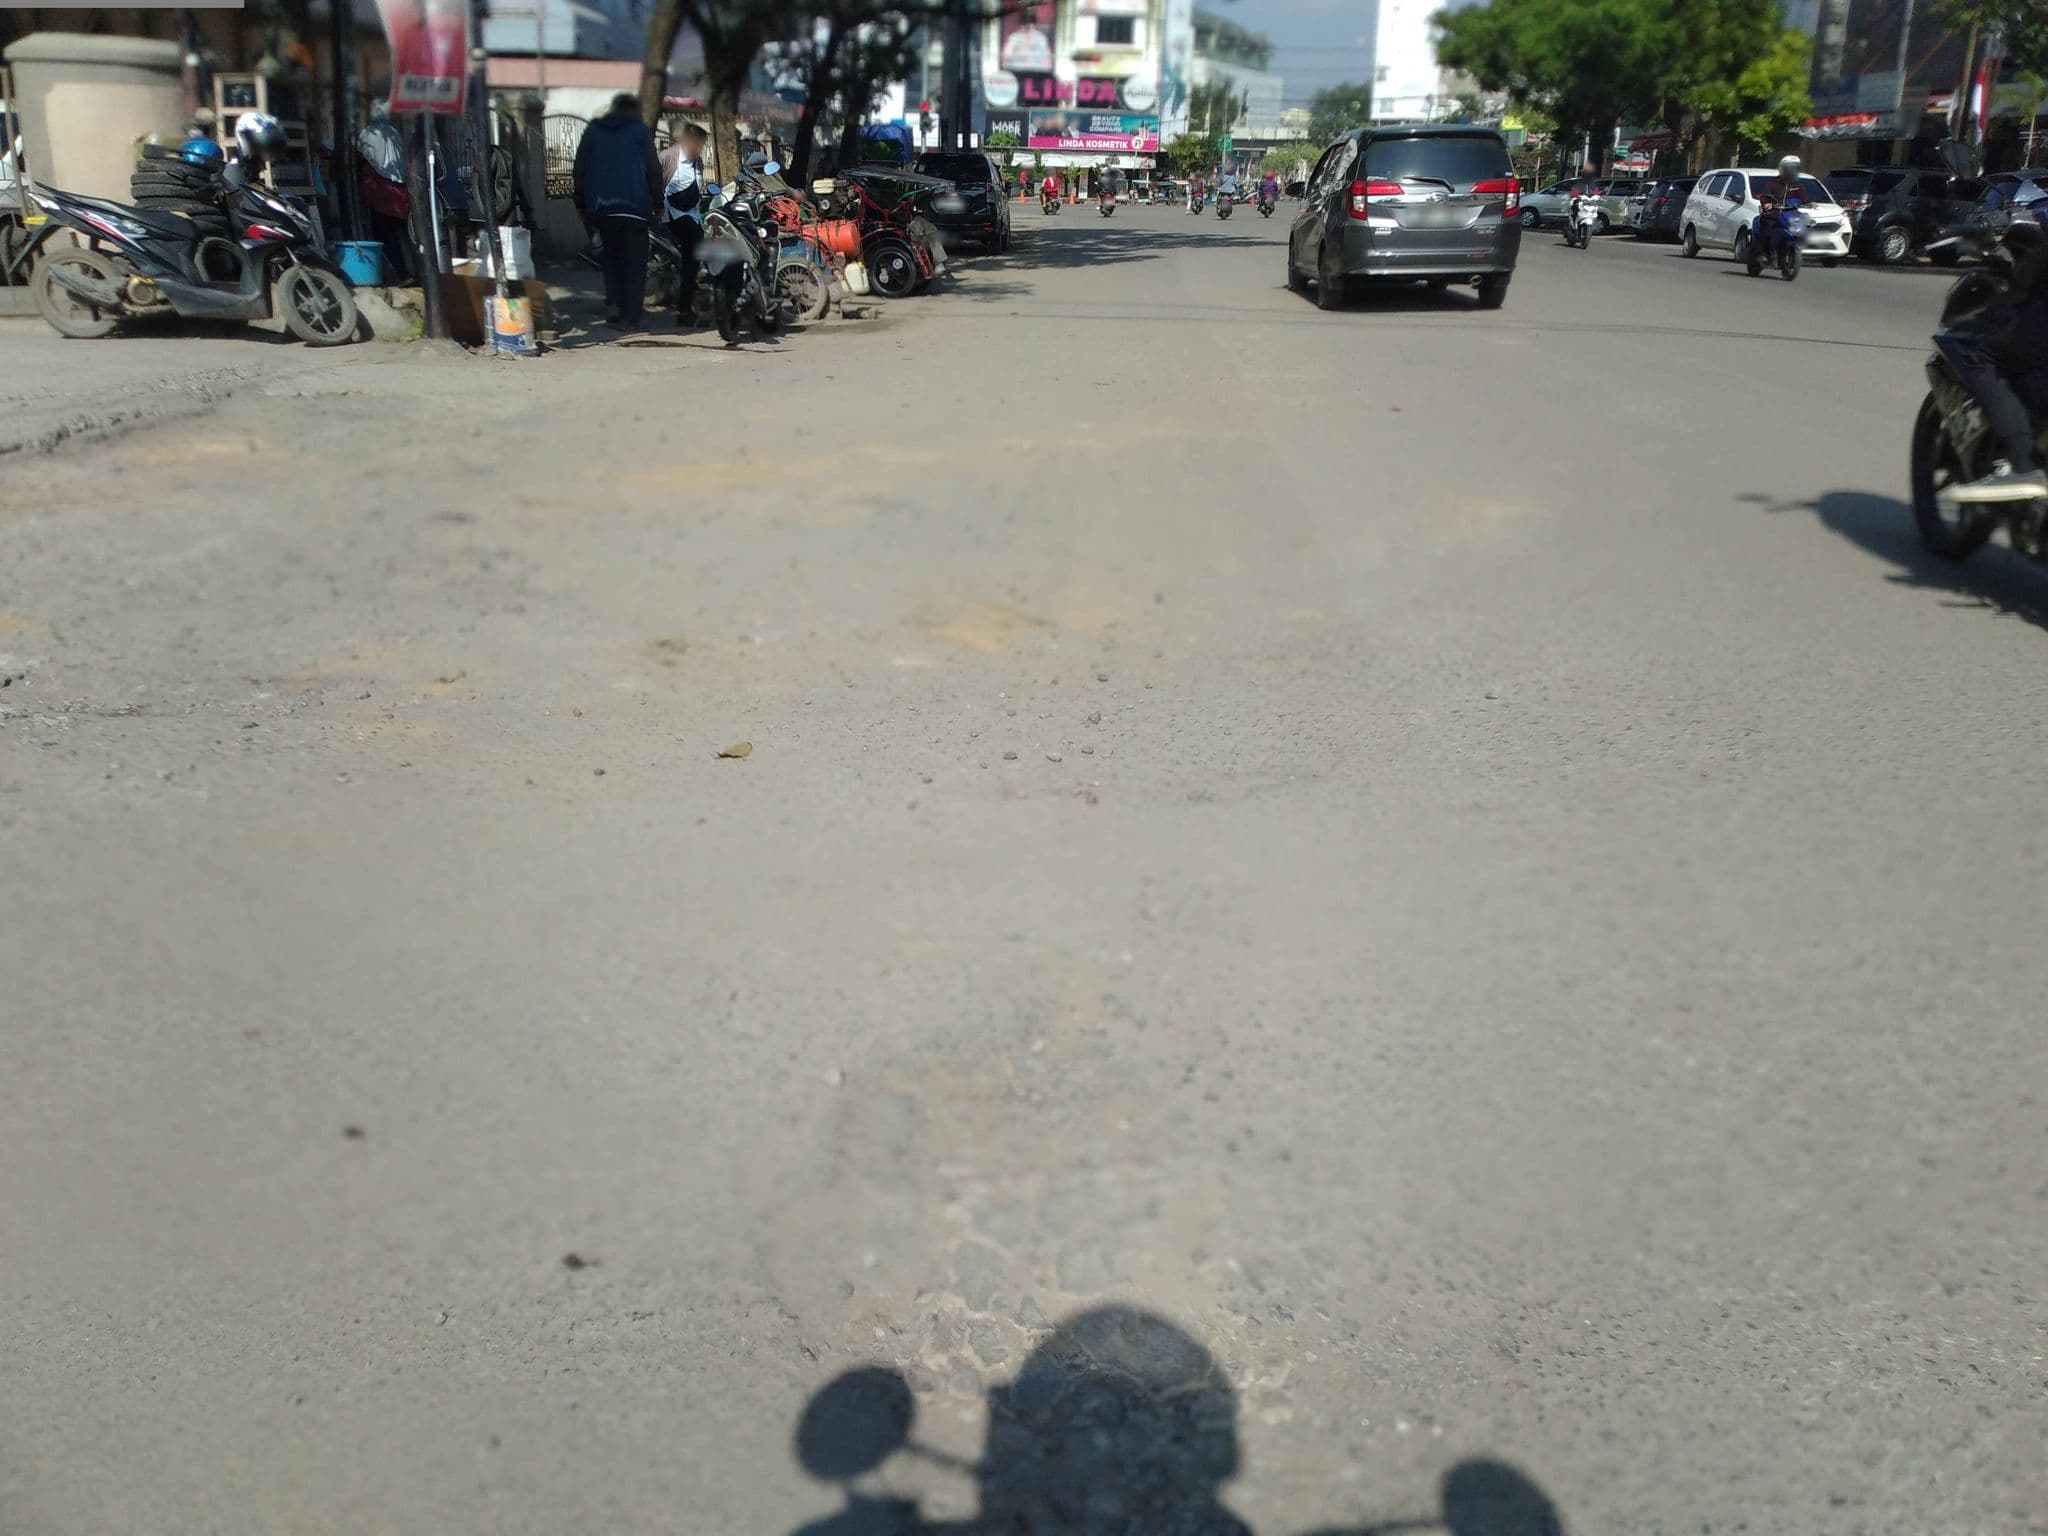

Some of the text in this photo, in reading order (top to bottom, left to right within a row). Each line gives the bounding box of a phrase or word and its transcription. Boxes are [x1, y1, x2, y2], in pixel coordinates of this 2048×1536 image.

[1023, 78, 1117, 102] LINDA
[1058, 139, 1129, 149] LINDA KOSMETIK
